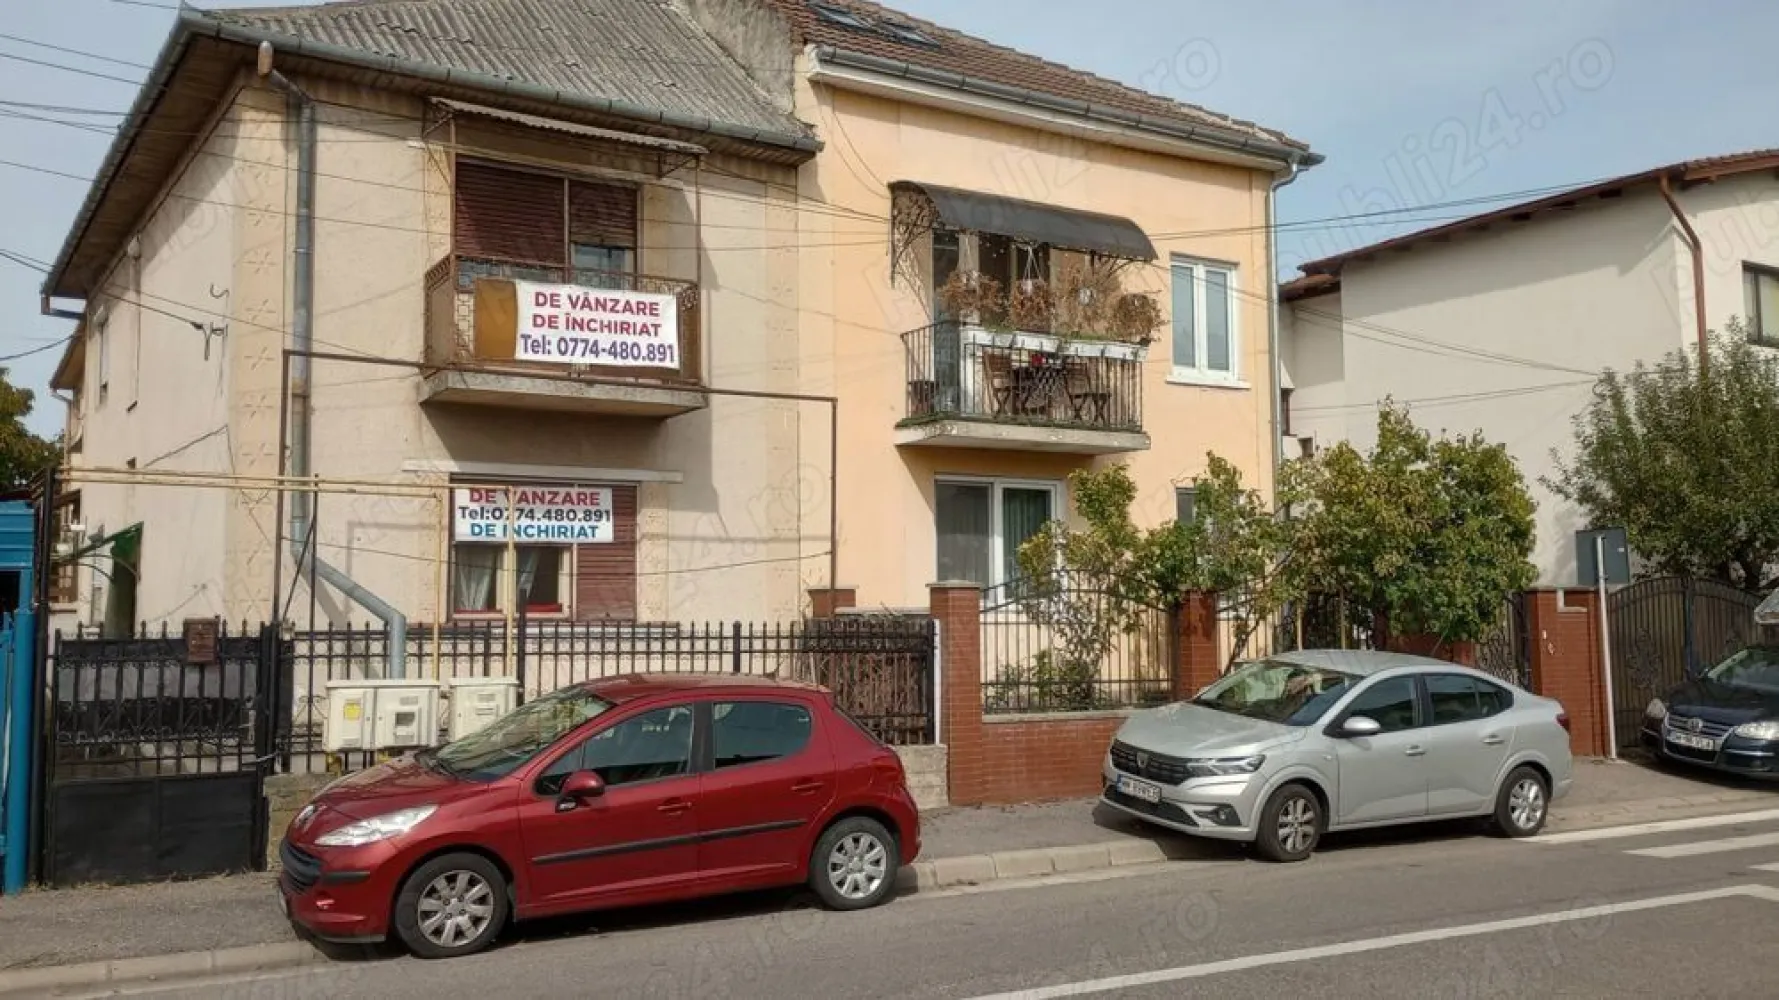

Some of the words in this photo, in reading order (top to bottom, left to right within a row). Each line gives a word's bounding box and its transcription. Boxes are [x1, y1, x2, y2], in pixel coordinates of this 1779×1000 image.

[534, 291, 561, 309] DE
[567, 292, 660, 317] VÂNZARE
[532, 314, 560, 330] DE
[565, 312, 662, 337] ÎNCHIRIAT
[520, 333, 552, 355] Tel:
[556, 336, 675, 363] 0774-480.891
[469, 488, 497, 504] DE
[471, 523, 497, 537] DE
